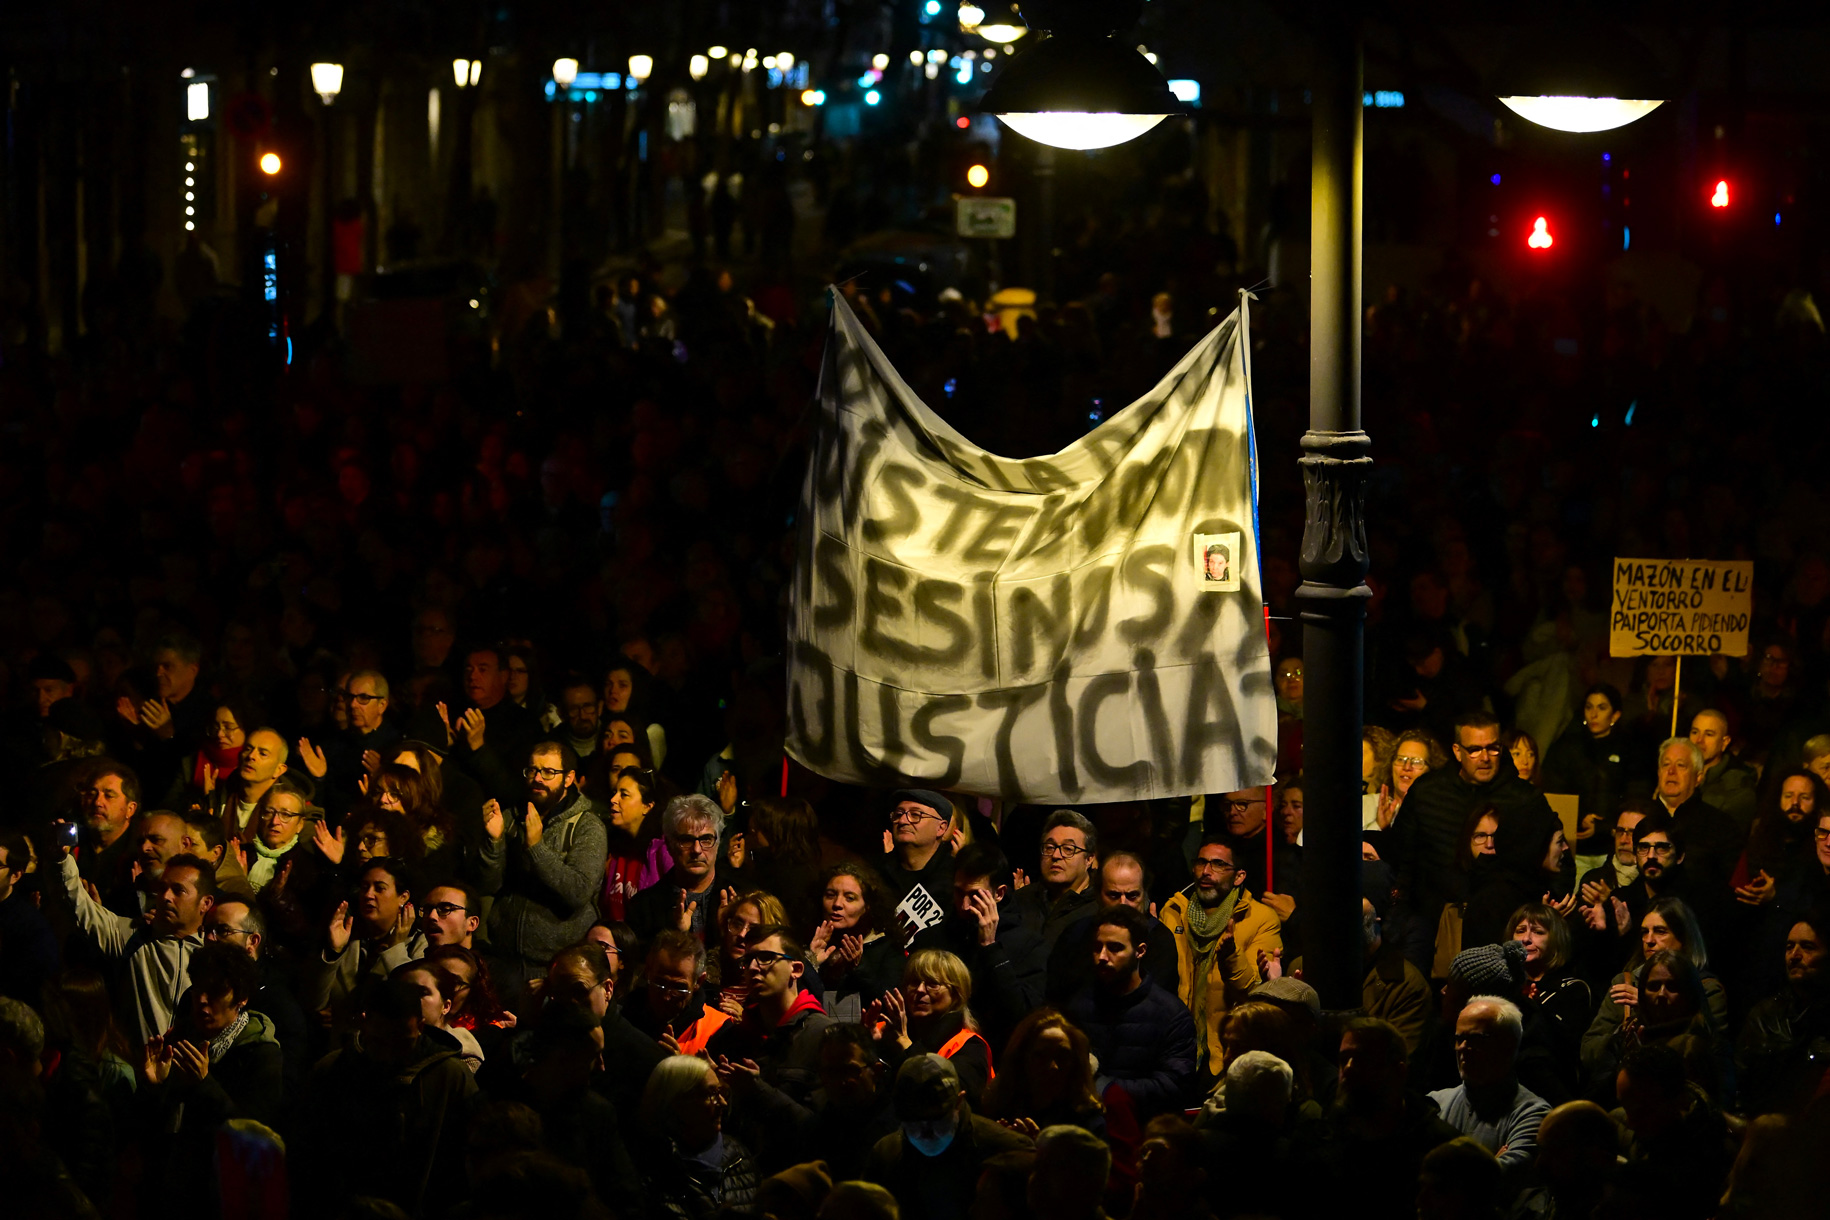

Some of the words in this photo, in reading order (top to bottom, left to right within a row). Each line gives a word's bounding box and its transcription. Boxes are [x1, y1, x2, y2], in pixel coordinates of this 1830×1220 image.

[1616, 561, 1684, 589] MAZÓN
[1690, 567, 1715, 591] EN
[1615, 589, 1703, 610] VENTORRO
[1612, 611, 1687, 633] PAIPORTA
[1691, 612, 1748, 633] PIDIENDO
[1632, 631, 1722, 653] SOCORRO
[905, 886, 934, 920] POR
